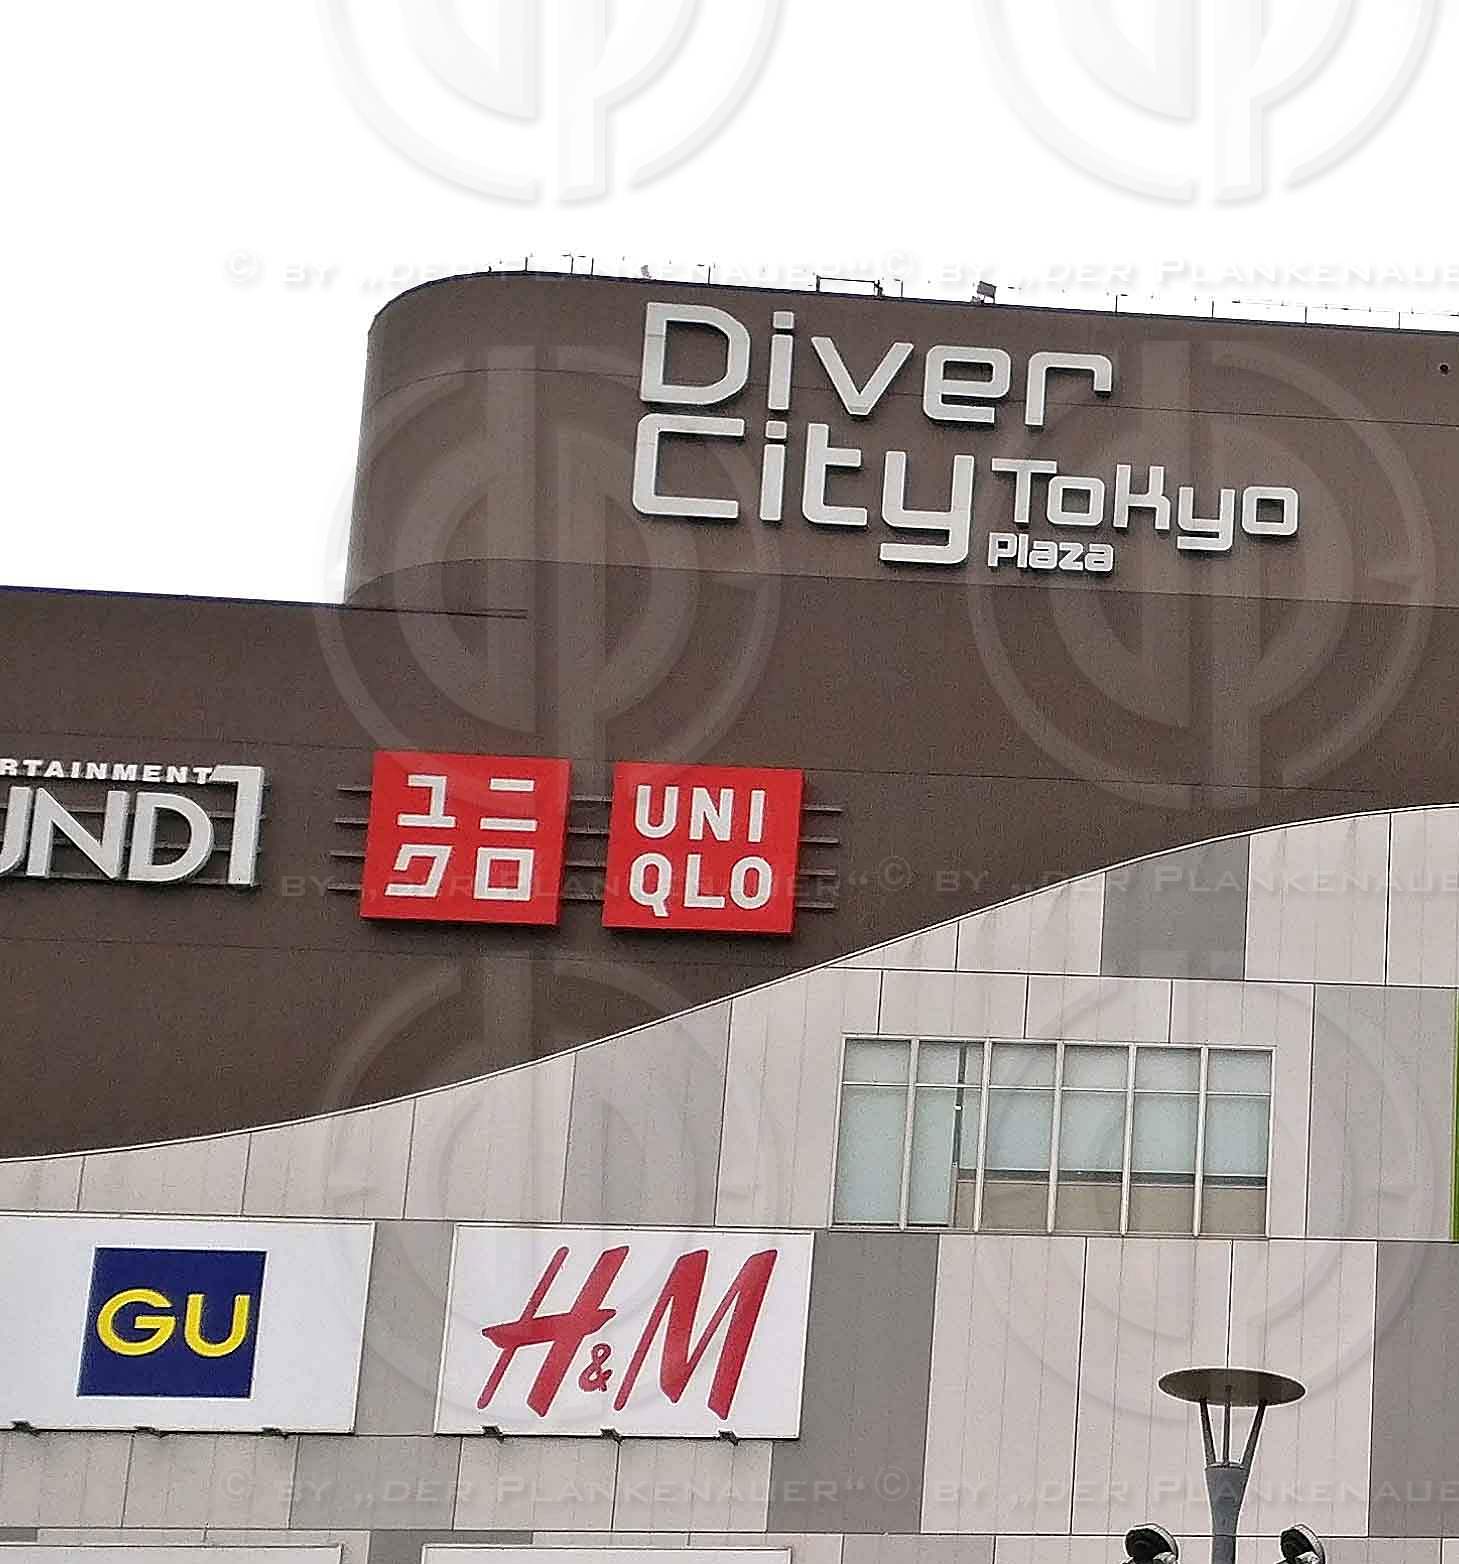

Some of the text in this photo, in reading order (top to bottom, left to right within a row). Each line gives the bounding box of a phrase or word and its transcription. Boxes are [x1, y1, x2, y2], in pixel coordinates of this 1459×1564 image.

[638, 301, 1114, 427] Diver
[632, 412, 1300, 565] City Tokyo
[988, 532, 1115, 574] Plaza
[397, 773, 539, 833] ユニ
[634, 783, 768, 844] UNI
[385, 843, 536, 903] クロ
[627, 852, 775, 917] QLO
[96, 1287, 252, 1358] GU
[477, 1244, 780, 1421] H&M
